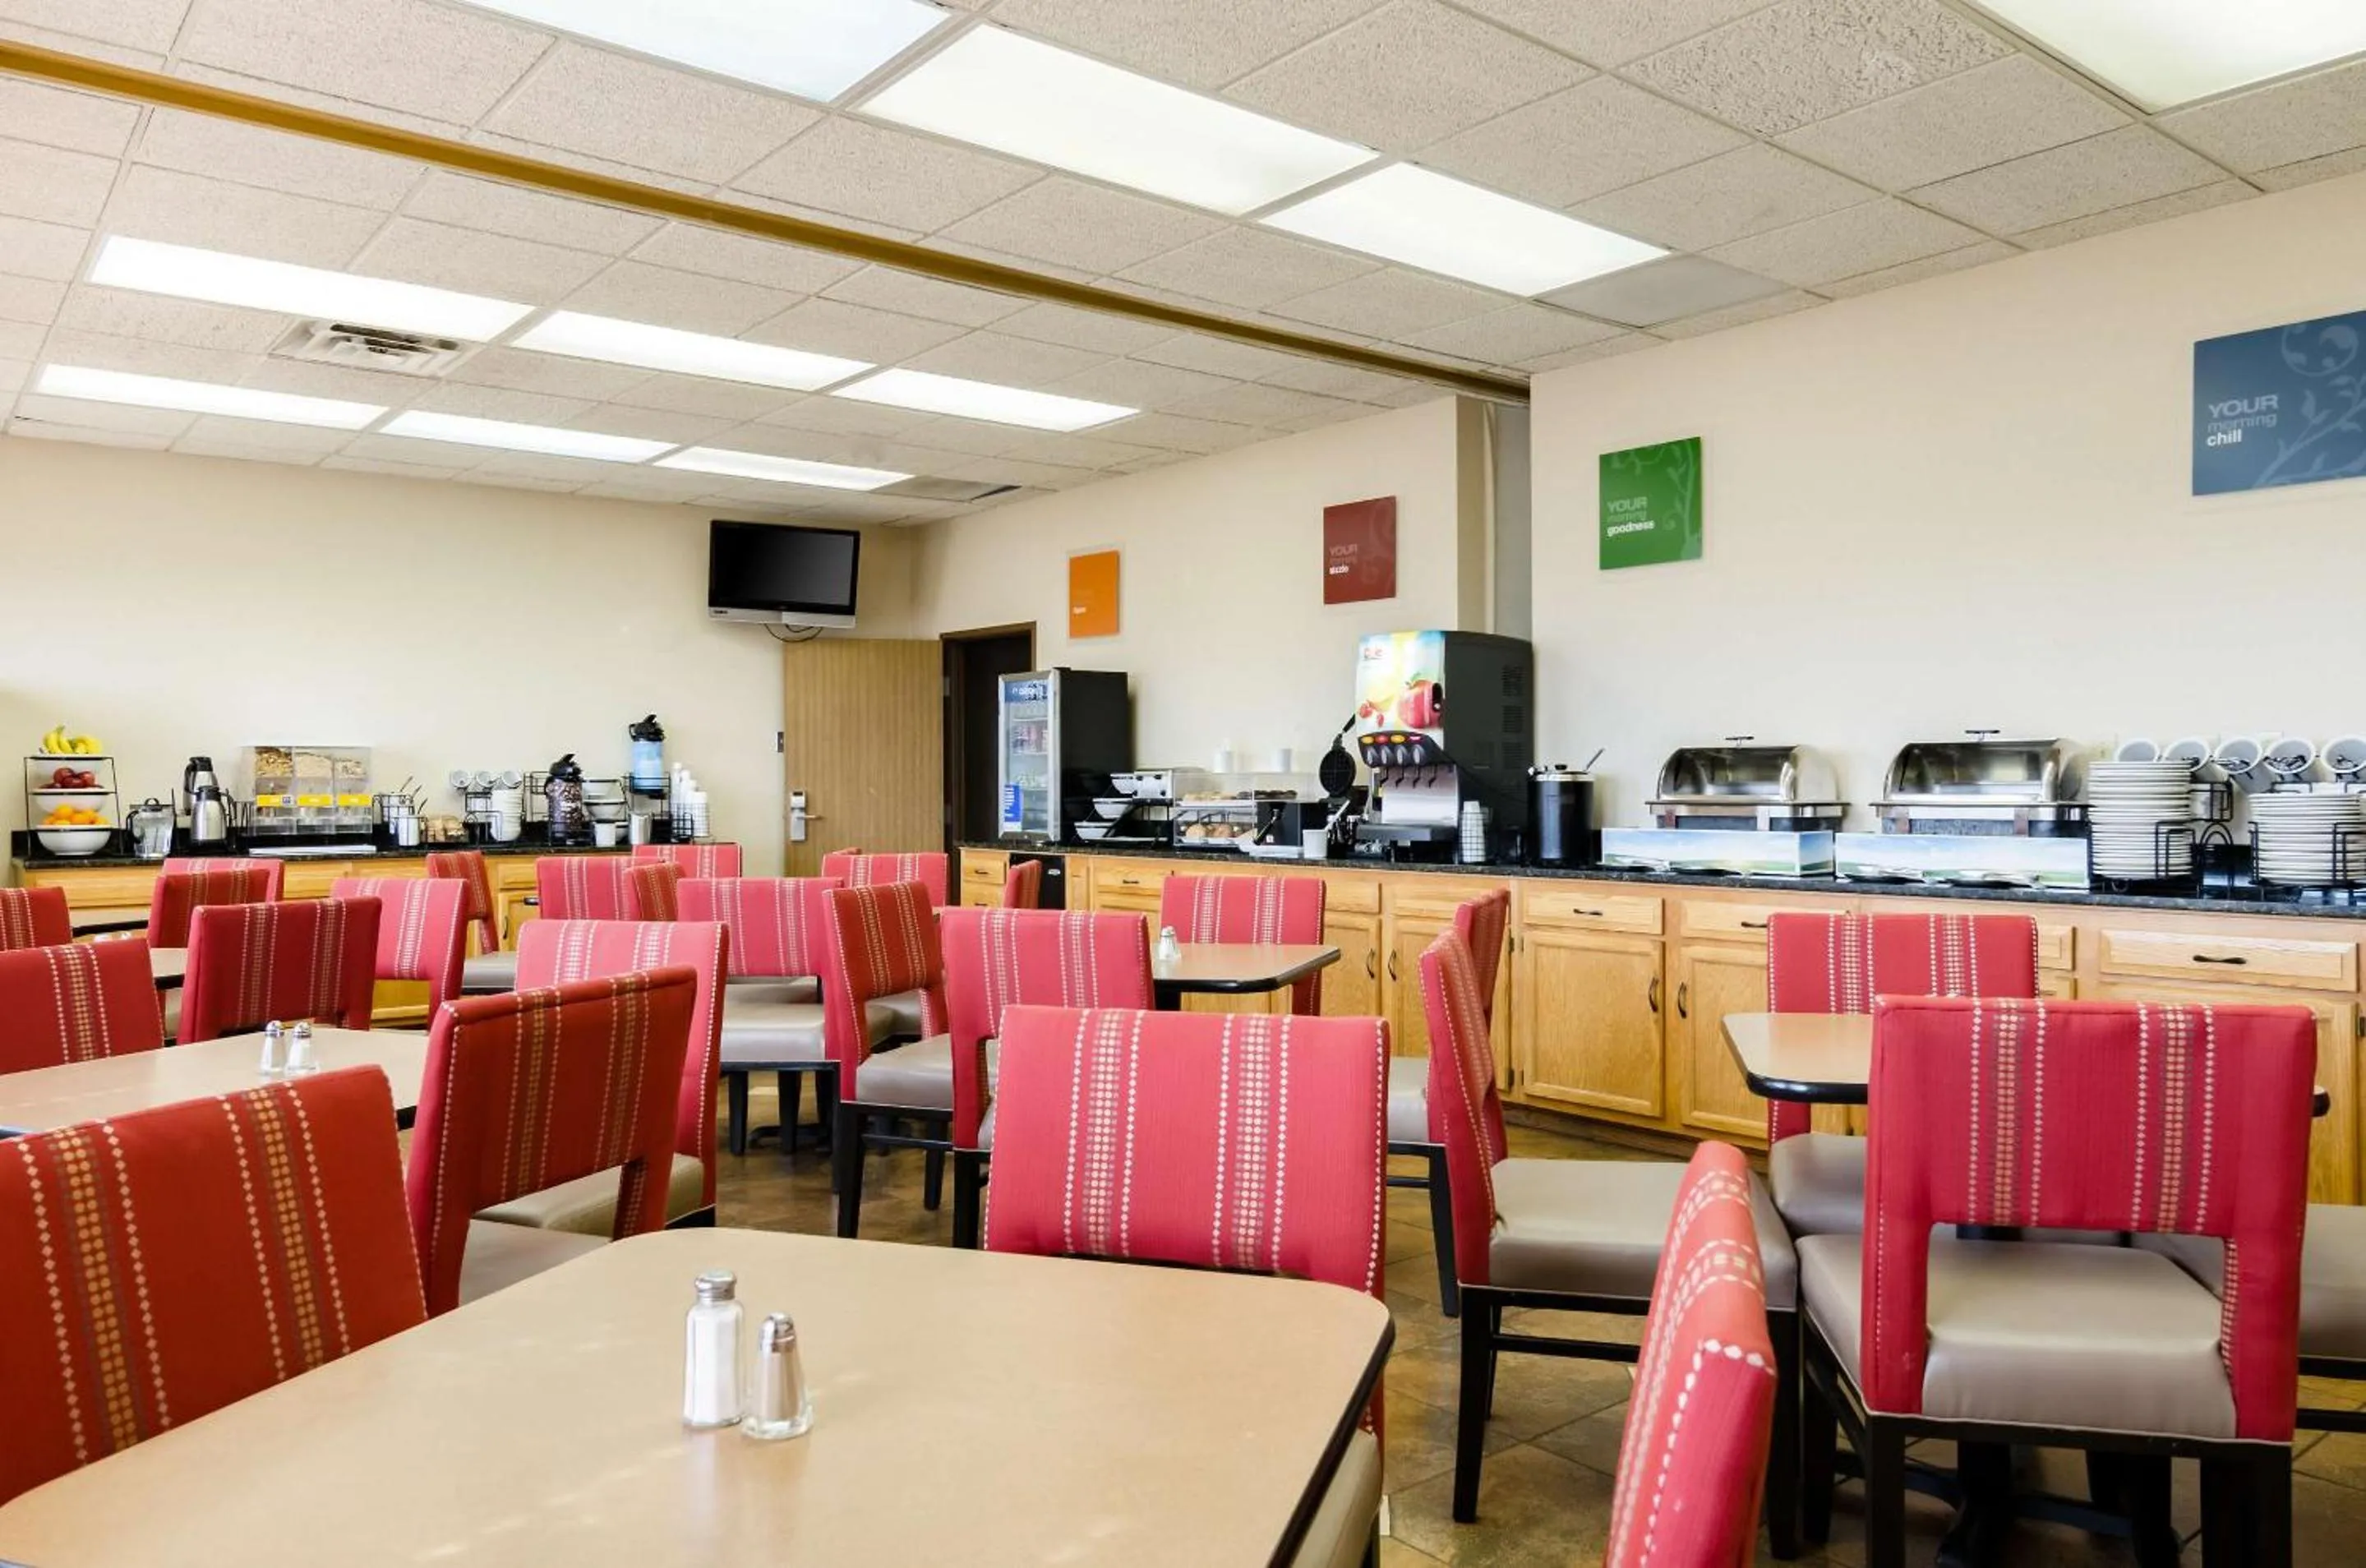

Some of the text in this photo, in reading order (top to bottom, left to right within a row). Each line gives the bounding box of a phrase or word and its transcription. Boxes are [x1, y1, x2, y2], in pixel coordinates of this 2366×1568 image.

[2208, 394, 2279, 418] YOUR
[2207, 413, 2277, 434] morning
[2207, 428, 2242, 446] chill
[1607, 496, 1648, 513] YOUR
[1607, 520, 1655, 537] goodness
